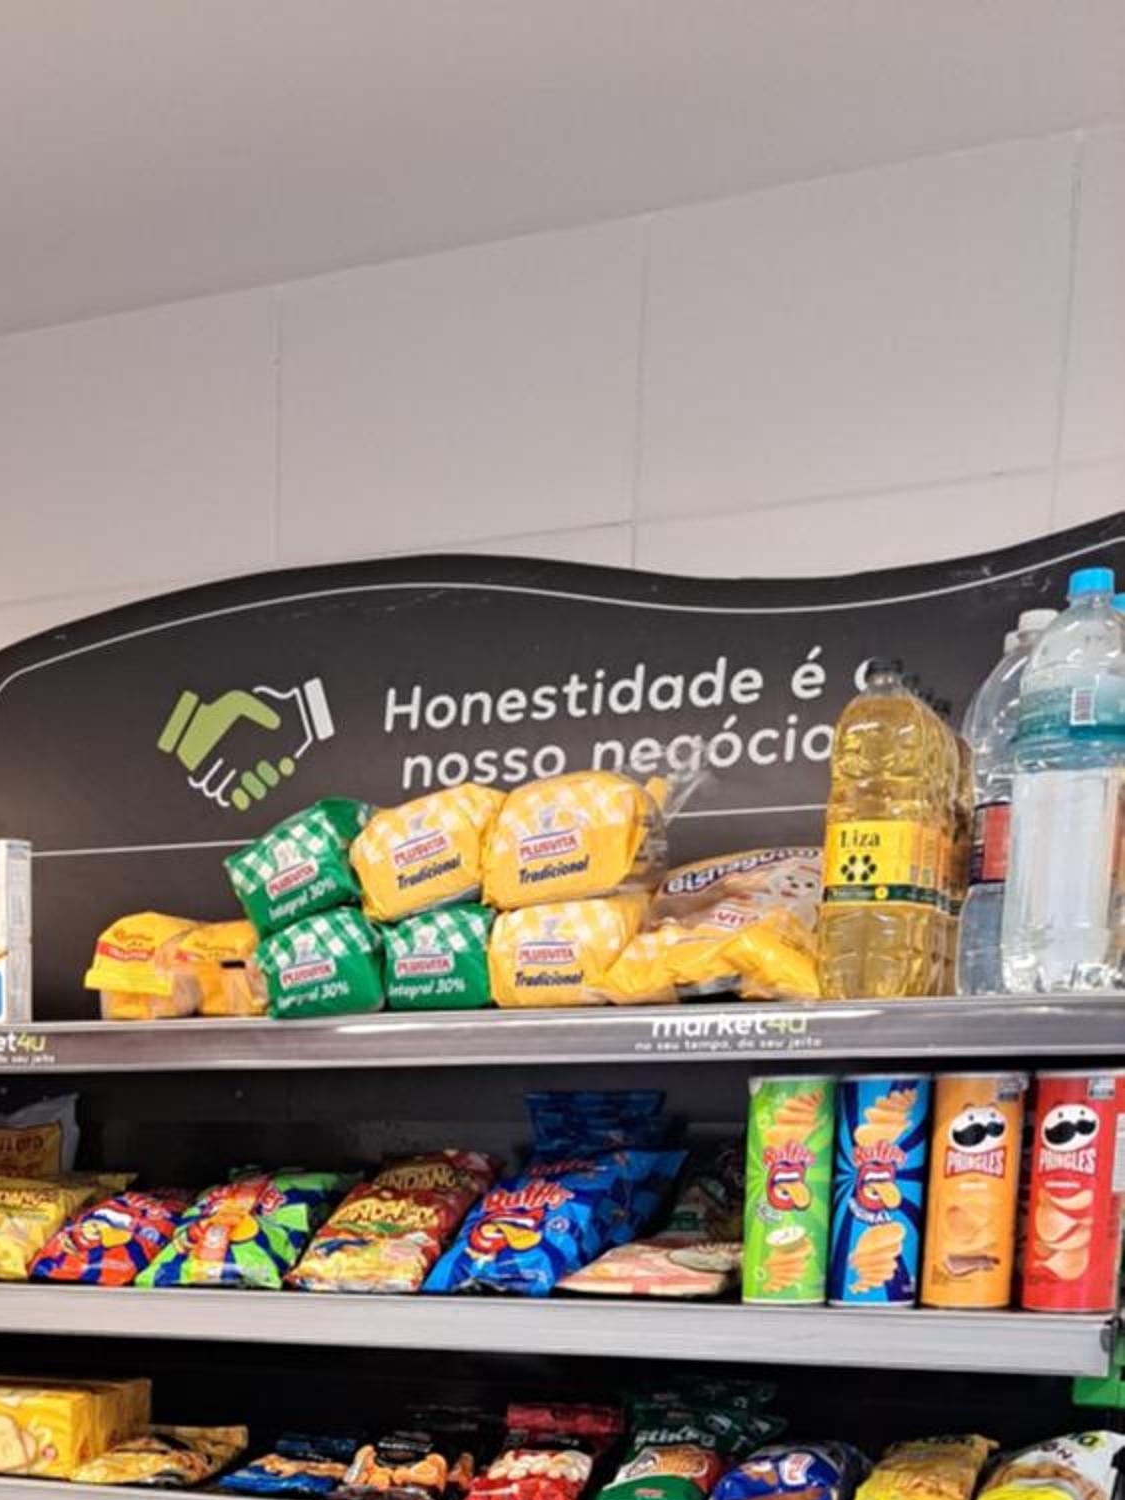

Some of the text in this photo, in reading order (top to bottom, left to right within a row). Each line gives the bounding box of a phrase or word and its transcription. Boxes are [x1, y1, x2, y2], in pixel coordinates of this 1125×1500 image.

[384, 656, 764, 732] Honestidade
[791, 646, 826, 699] é
[402, 715, 836, 790] nosso negócio
[839, 828, 882, 849] Liza
[945, 1146, 1007, 1178] PRINGLES
[1039, 1147, 1097, 1175] PRINGLES
